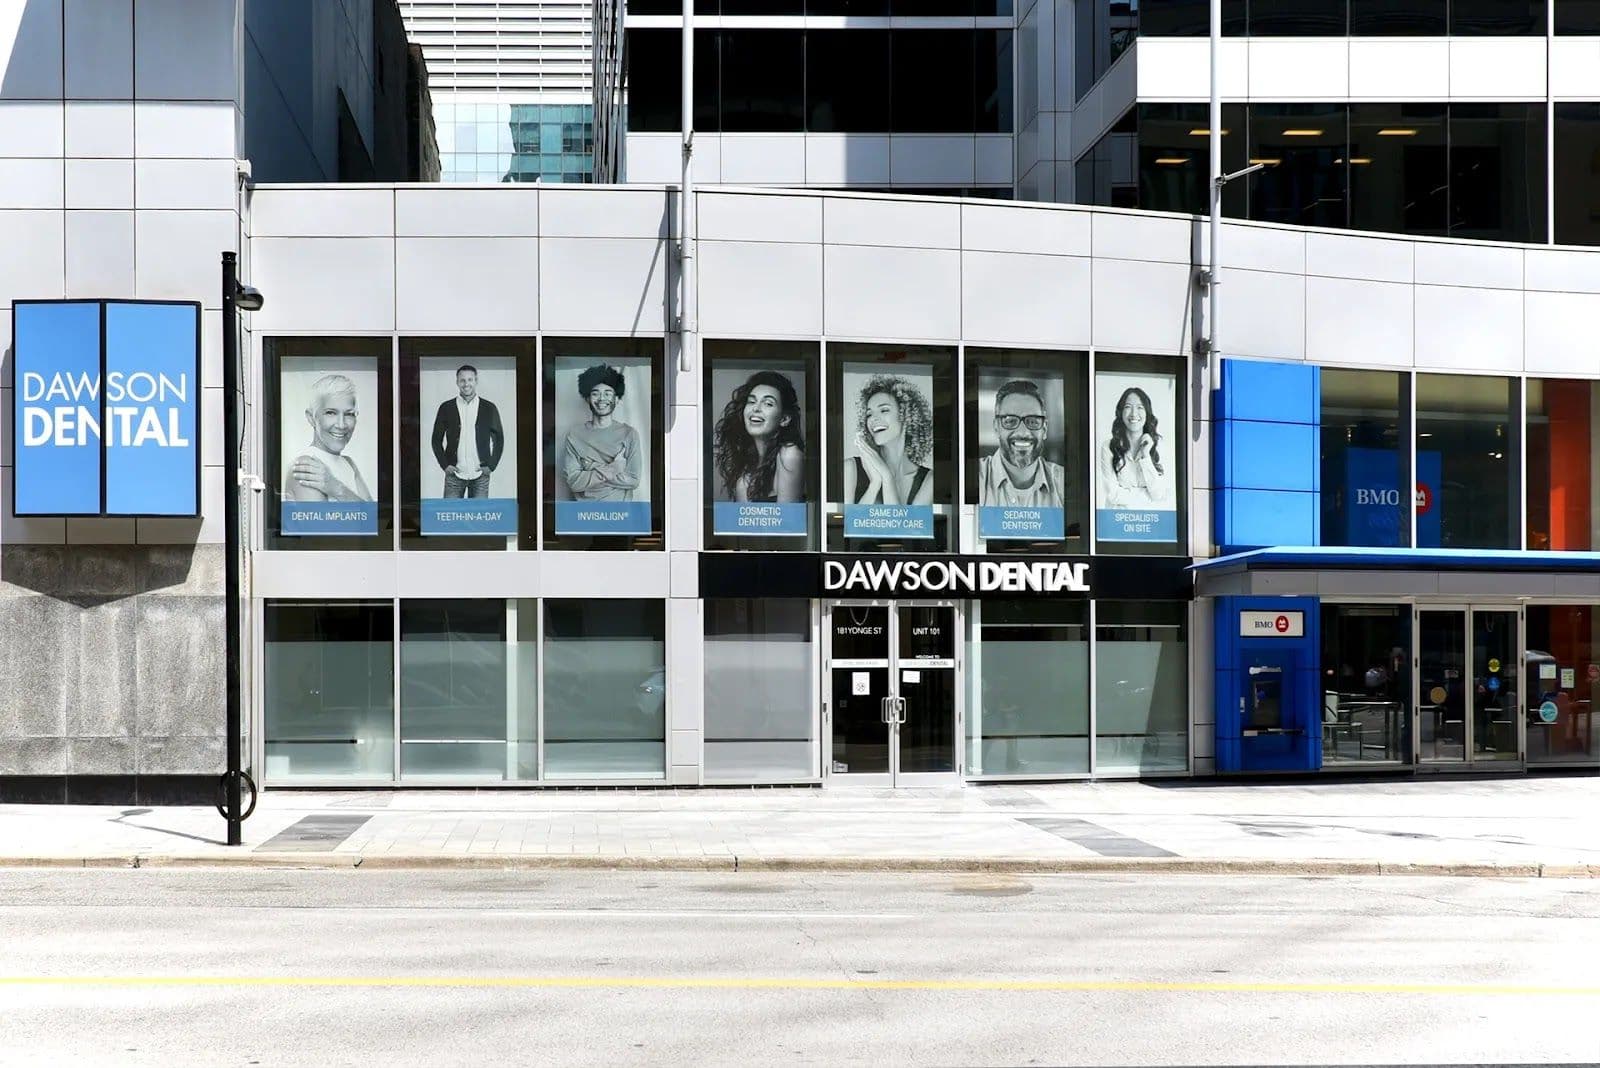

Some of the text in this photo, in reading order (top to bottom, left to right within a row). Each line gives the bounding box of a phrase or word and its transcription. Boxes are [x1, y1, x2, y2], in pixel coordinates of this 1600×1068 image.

[23, 371, 186, 402] DAWSON
[23, 405, 189, 446] DENTAL
[1356, 488, 1399, 505] BMO
[740, 506, 781, 515] COSMETIC
[869, 508, 908, 517] SAME DAY
[1004, 510, 1040, 519] SEDATION
[291, 511, 367, 520] DENTAL IMPLANTS
[436, 511, 502, 520] TEETH-IN-A-DAY
[1114, 512, 1159, 522] SPECIALISTS
[738, 517, 782, 526] DENTISTRY
[853, 519, 924, 528] EMERGENCY CARE
[1002, 521, 1042, 530] DENTISTRY
[1123, 524, 1151, 532] ON SITE
[824, 560, 1090, 592] DAWSON DENTAL
